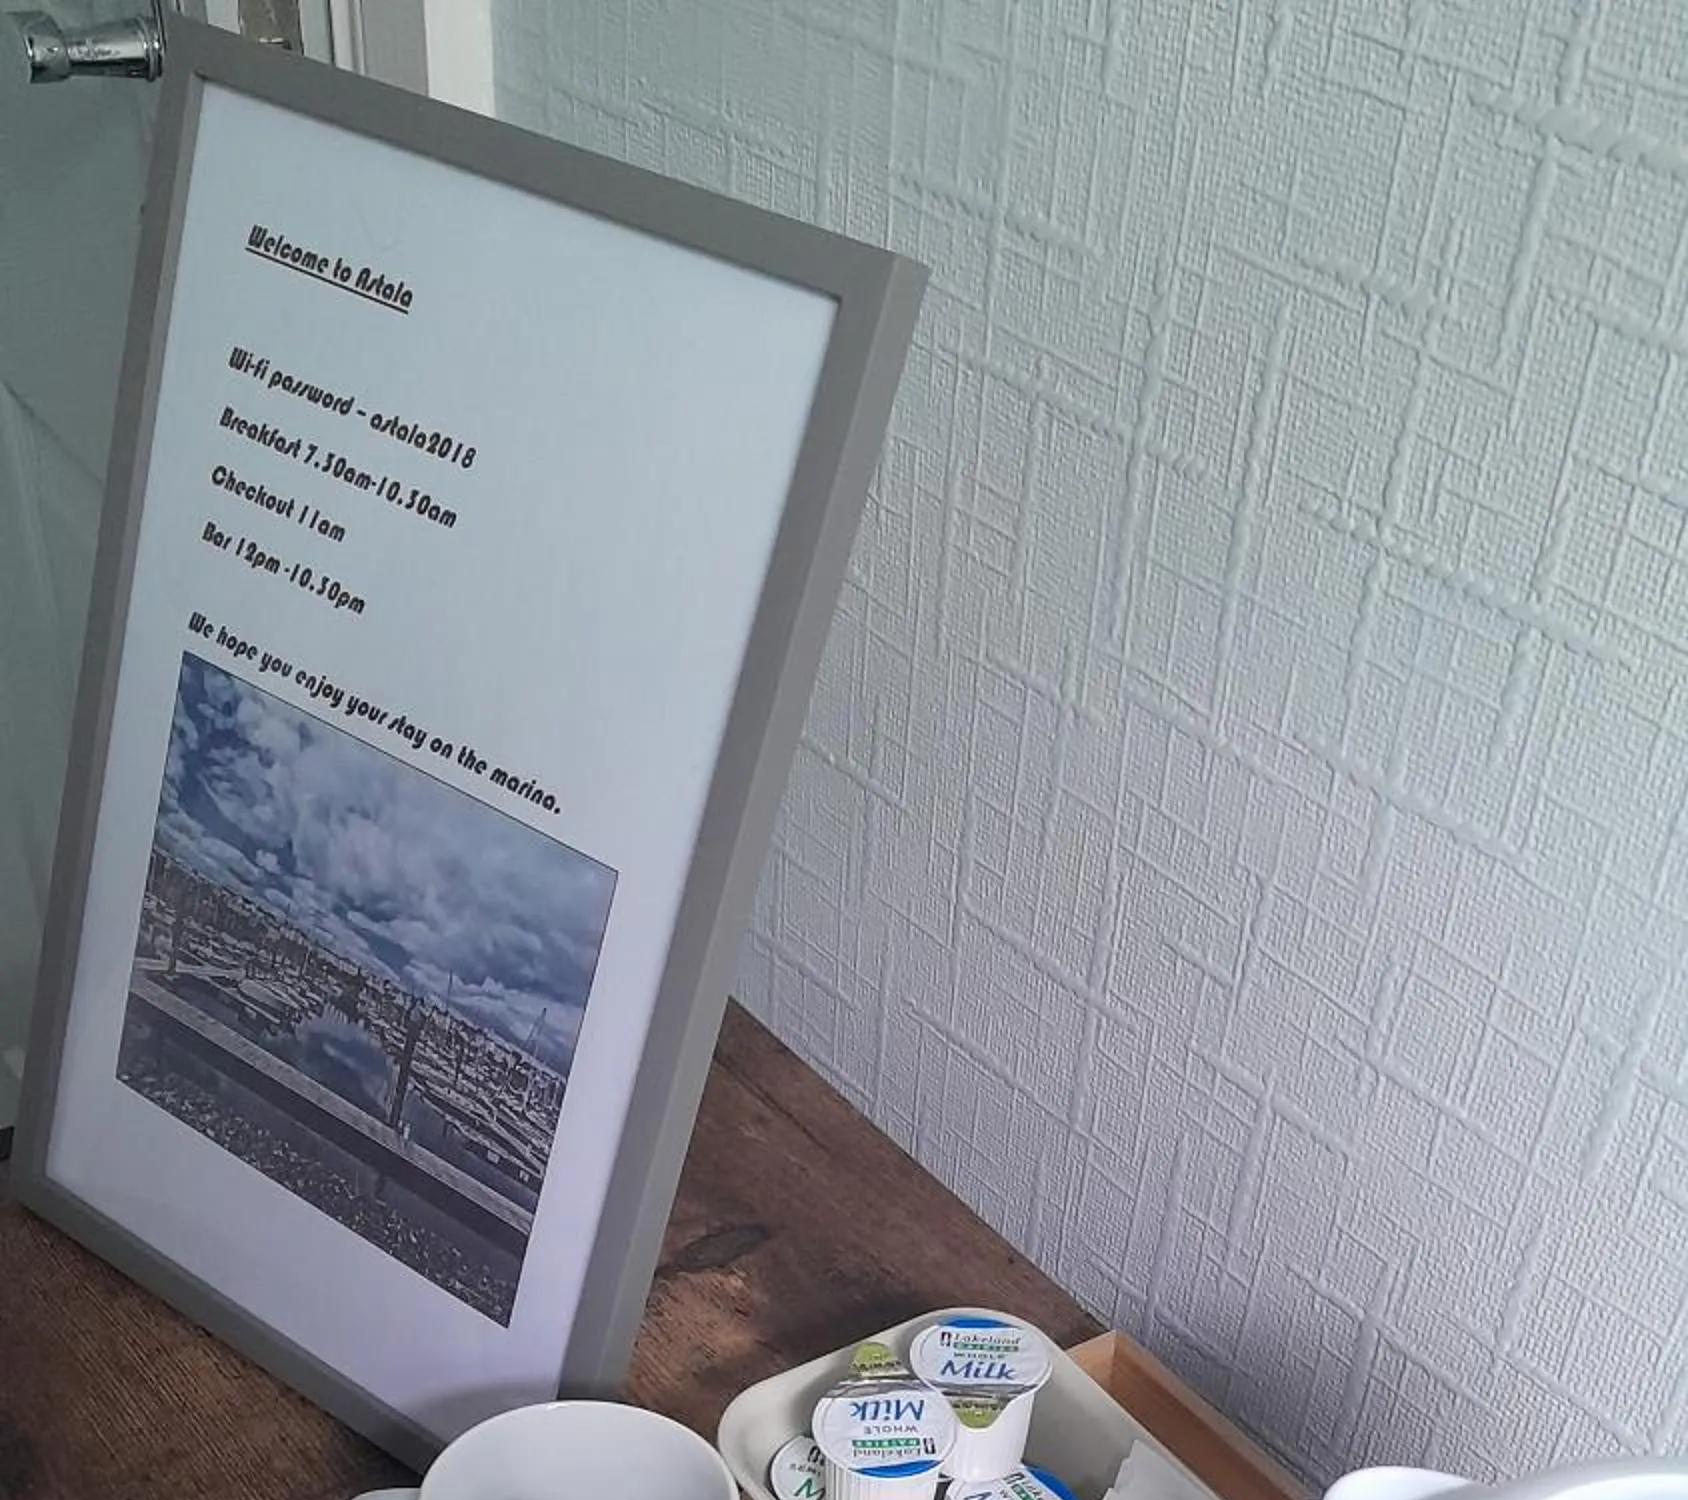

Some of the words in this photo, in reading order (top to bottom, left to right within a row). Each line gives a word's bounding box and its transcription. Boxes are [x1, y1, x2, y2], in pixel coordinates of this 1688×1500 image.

[247, 224, 329, 274] Welcome
[333, 256, 351, 282] to
[355, 266, 413, 308] Astala
[229, 347, 269, 381] Wi-fi
[267, 366, 354, 417] password
[370, 411, 476, 470] astala2018
[219, 406, 302, 459] Breakfast
[303, 442, 457, 529] 7.30am-10.30am
[211, 464, 295, 519] Checkout
[298, 504, 346, 544] 11am
[202, 521, 232, 551] Bar
[236, 533, 281, 576] 12pm
[188, 611, 215, 639] We
[216, 625, 258, 661] hope
[259, 650, 292, 678] you
[295, 668, 345, 708] enjoy
[344, 693, 388, 726] your
[388, 714, 428, 750] stay
[430, 735, 453, 759] on
[457, 744, 487, 775] the
[490, 766, 562, 815] marina.
[940, 1359, 1016, 1380] Milk
[849, 1399, 925, 1421] Milk
[864, 1425, 918, 1435] WHOLE
[853, 1447, 920, 1457] Lakeland
